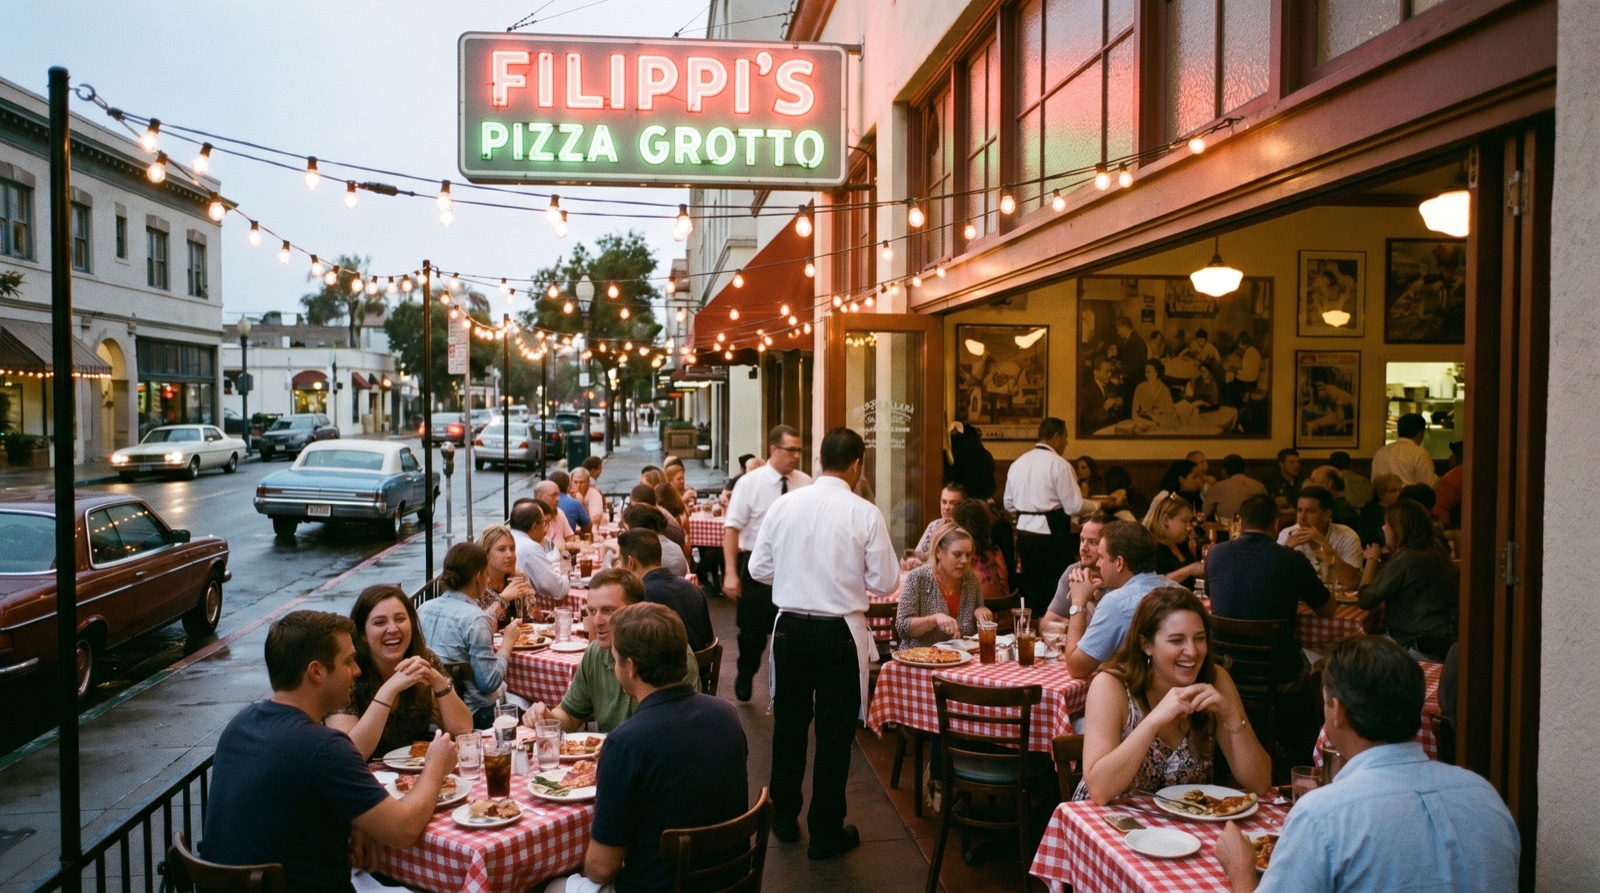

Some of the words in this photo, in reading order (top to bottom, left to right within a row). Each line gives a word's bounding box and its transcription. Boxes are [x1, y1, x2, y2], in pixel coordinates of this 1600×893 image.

[491, 50, 816, 116] FILIPPI'S
[480, 121, 620, 163] PIZZA
[639, 125, 825, 169] GROTTO
